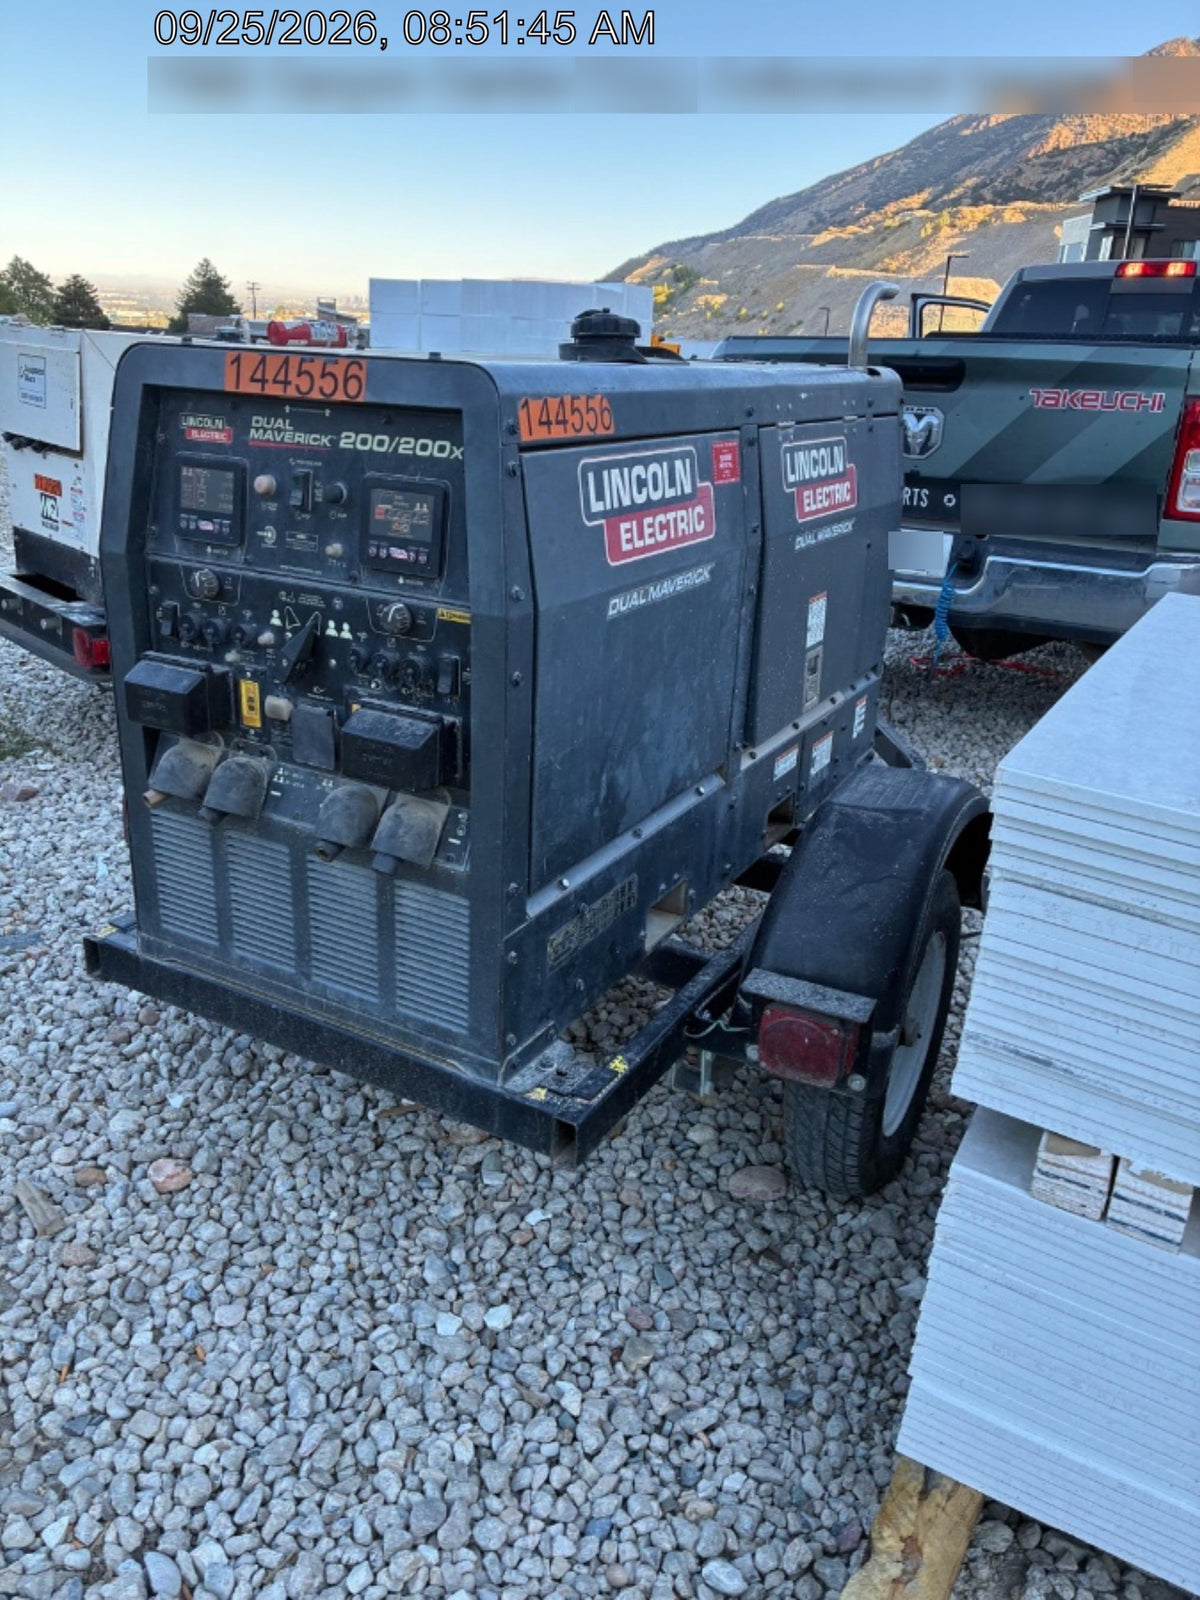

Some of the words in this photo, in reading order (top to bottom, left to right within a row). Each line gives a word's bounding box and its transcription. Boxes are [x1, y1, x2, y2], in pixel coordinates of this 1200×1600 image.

[230, 352, 364, 400] 144556
[181, 415, 223, 429] LINCOLN
[251, 416, 294, 430] DUAL
[519, 397, 613, 437] 144556
[191, 429, 229, 440] ELECTRIC
[249, 428, 332, 447] MAVERICK
[786, 446, 844, 482] LINCOLN
[587, 458, 693, 513] LINCOLN
[803, 481, 851, 512] ELECTRIC
[903, 486, 929, 507] RTS
[619, 505, 705, 551] ELECTRIC
[607, 591, 646, 616] DUAL
[648, 564, 712, 602] MAVERICK
